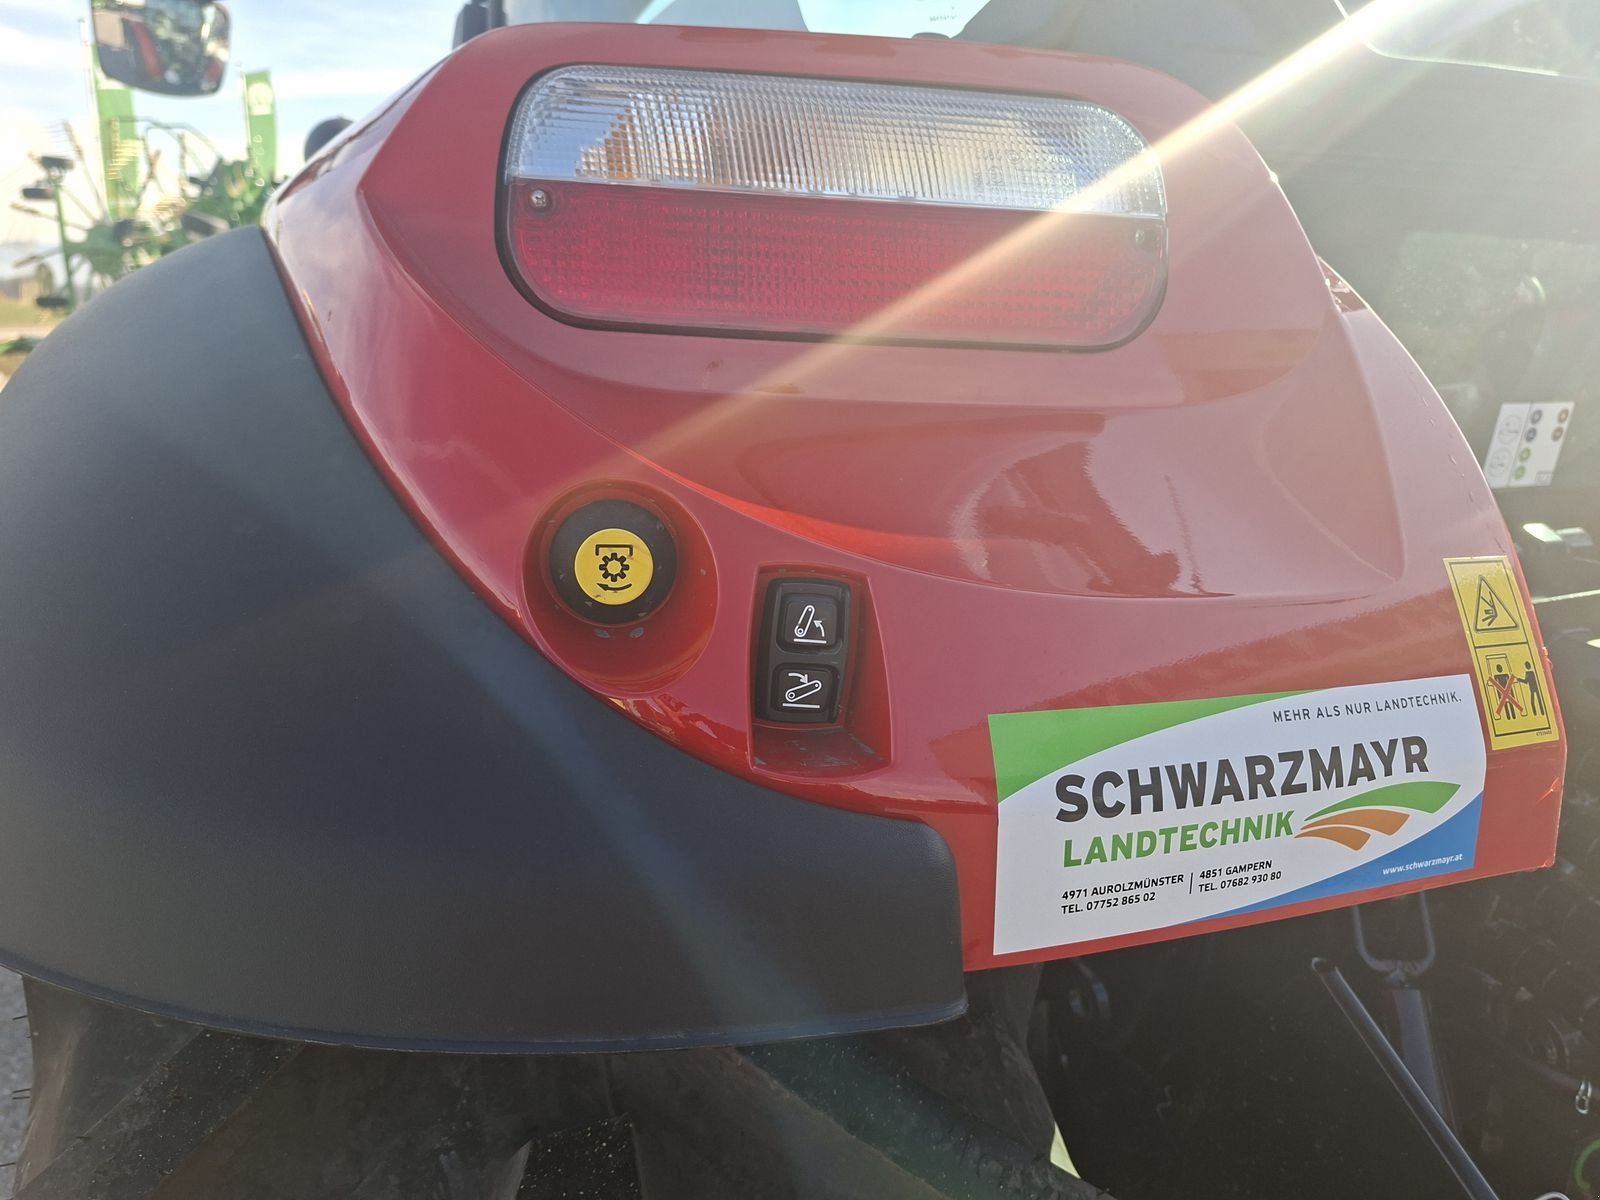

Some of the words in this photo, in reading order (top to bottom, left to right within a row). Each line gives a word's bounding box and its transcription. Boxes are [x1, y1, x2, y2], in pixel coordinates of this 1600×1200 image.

[1273, 708, 1310, 723] MEHR
[1316, 705, 1341, 719] ALS
[1345, 702, 1372, 715] NUR
[1376, 691, 1462, 712] LANDTECHNIK.
[1055, 735, 1430, 823] SCHWARZMAYR
[1063, 810, 1296, 868] LANDTECHNIK
[1199, 868, 1223, 880] 4851
[1225, 860, 1273, 876] GAMPERN
[1382, 853, 1463, 875] www.schwarzmayr.at
[1062, 888, 1088, 900] 4971
[1091, 874, 1185, 897] AUROLZMÜNSTER
[1199, 883, 1218, 893] TEL.
[1220, 876, 1249, 889] 07682
[1251, 873, 1268, 884] 930
[1270, 871, 1282, 880] 80
[1061, 904, 1083, 915] TEL.
[1086, 899, 1119, 911] 07752
[1121, 895, 1141, 906] 865
[1143, 892, 1156, 902] 02
